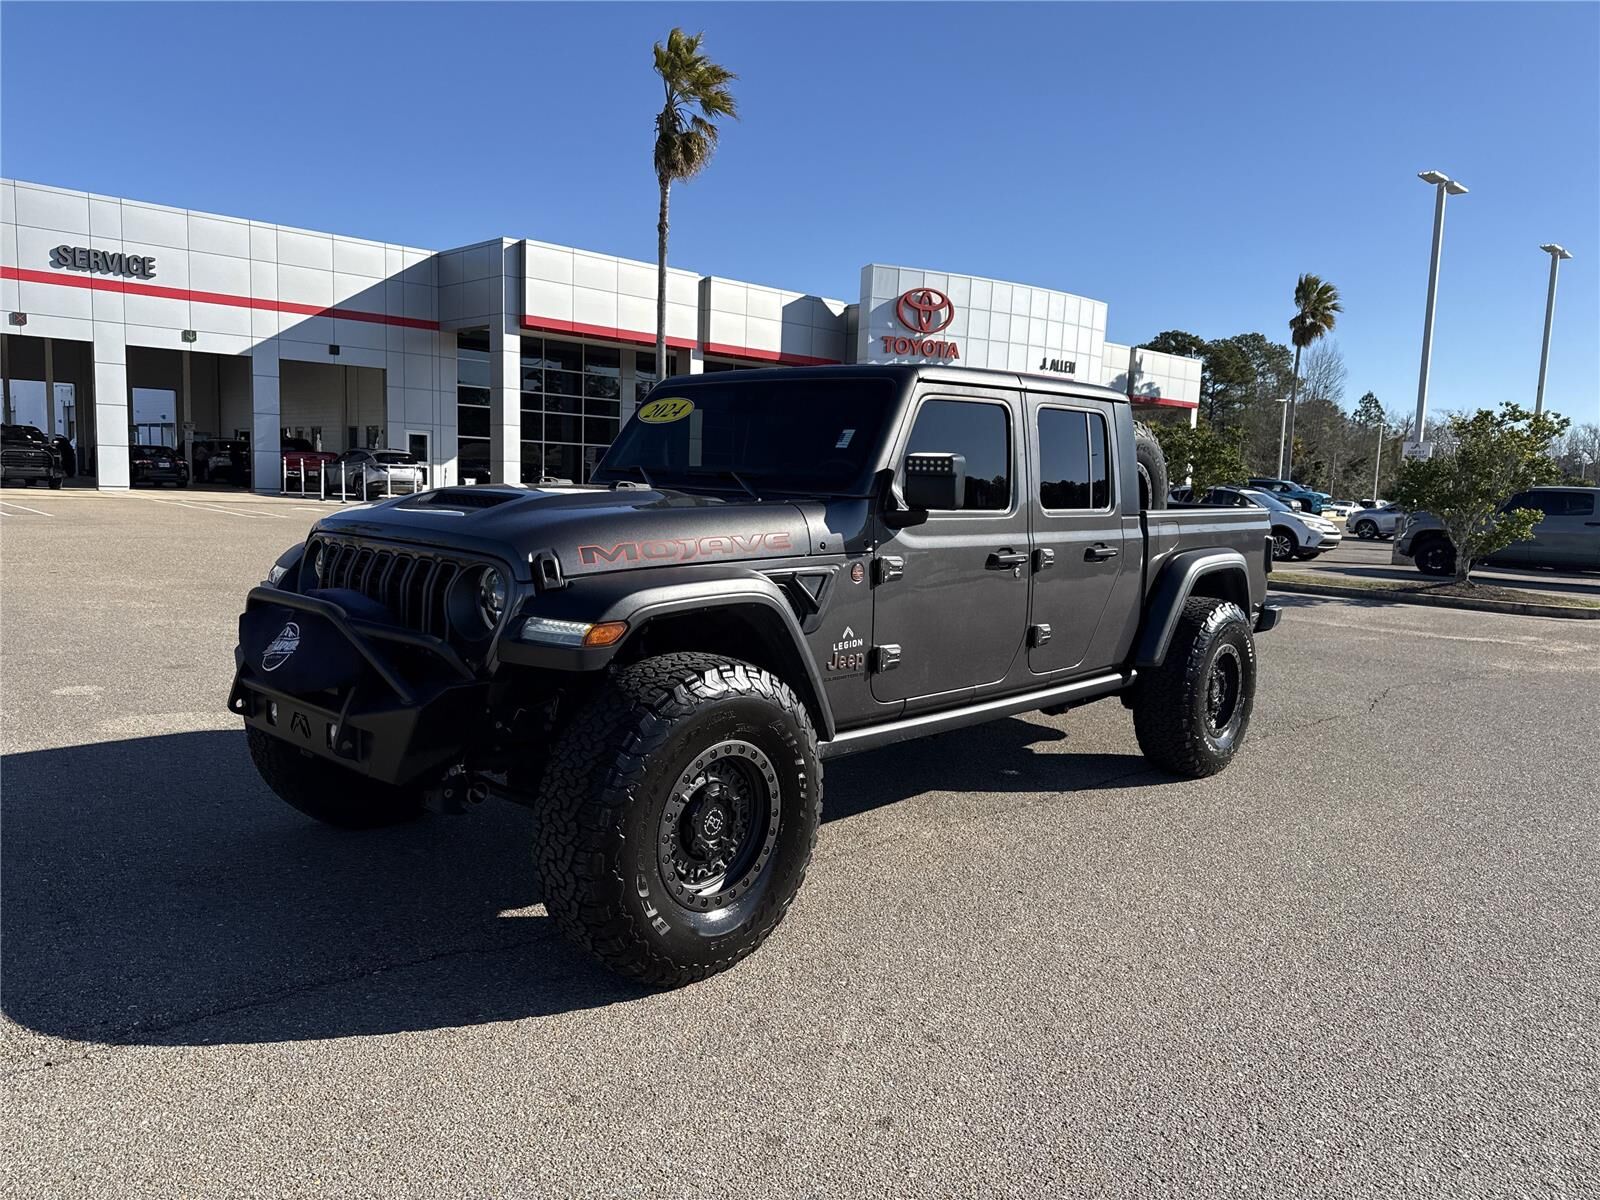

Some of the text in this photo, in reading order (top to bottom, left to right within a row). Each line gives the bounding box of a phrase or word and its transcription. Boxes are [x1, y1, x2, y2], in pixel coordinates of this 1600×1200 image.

[53, 244, 157, 279] SERVICE
[882, 335, 960, 360] TOYOTA
[1039, 357, 1076, 374] J. ALLEN
[643, 402, 689, 419] 2024
[578, 531, 792, 565] MOJAVE
[833, 639, 863, 651] LEGION
[826, 651, 865, 672] Jeep
